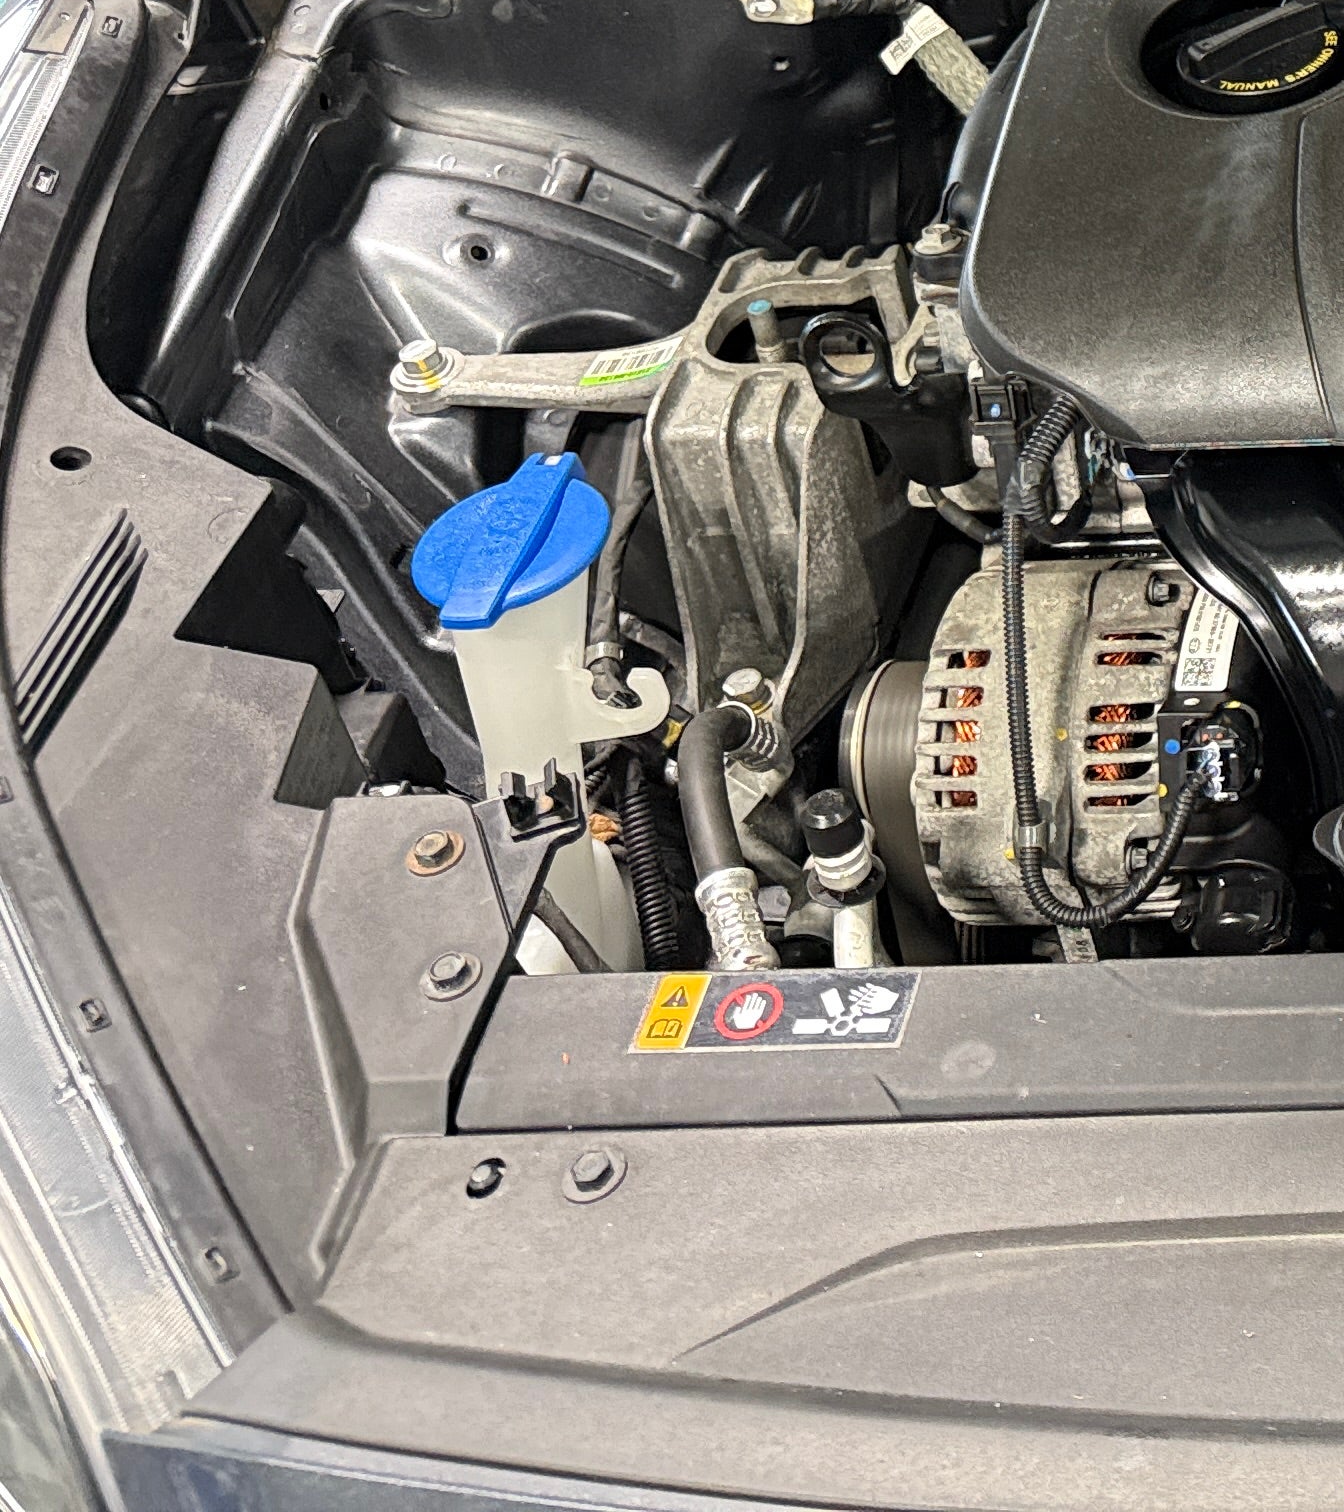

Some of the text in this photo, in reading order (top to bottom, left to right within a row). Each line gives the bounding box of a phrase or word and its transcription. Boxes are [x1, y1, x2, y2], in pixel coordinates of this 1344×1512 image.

[1219, 30, 1339, 91] SEE OWNER'S MANUAL
